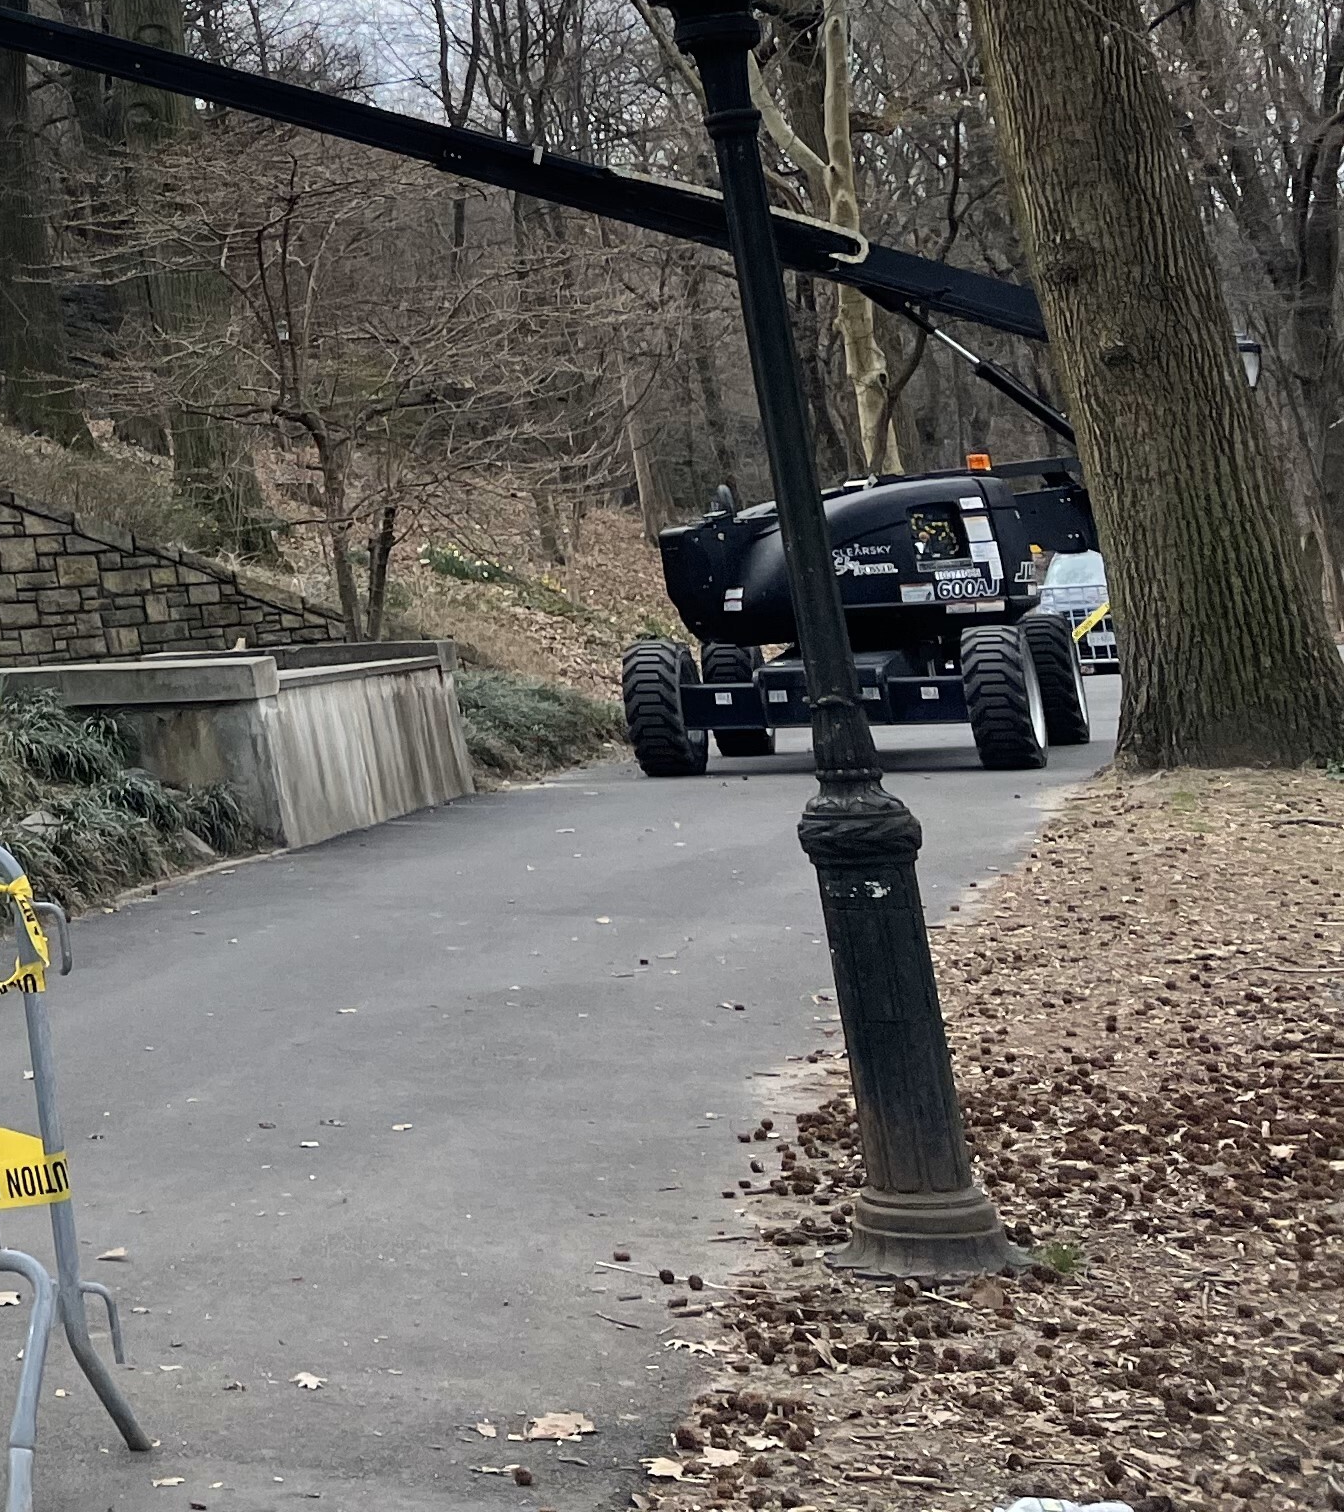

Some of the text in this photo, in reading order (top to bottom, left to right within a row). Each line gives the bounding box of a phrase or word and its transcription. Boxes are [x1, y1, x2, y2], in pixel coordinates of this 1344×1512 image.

[831, 543, 891, 558] CLEARSKY
[937, 578, 1000, 599] 600AJ
[5, 1159, 70, 1199] UTION
